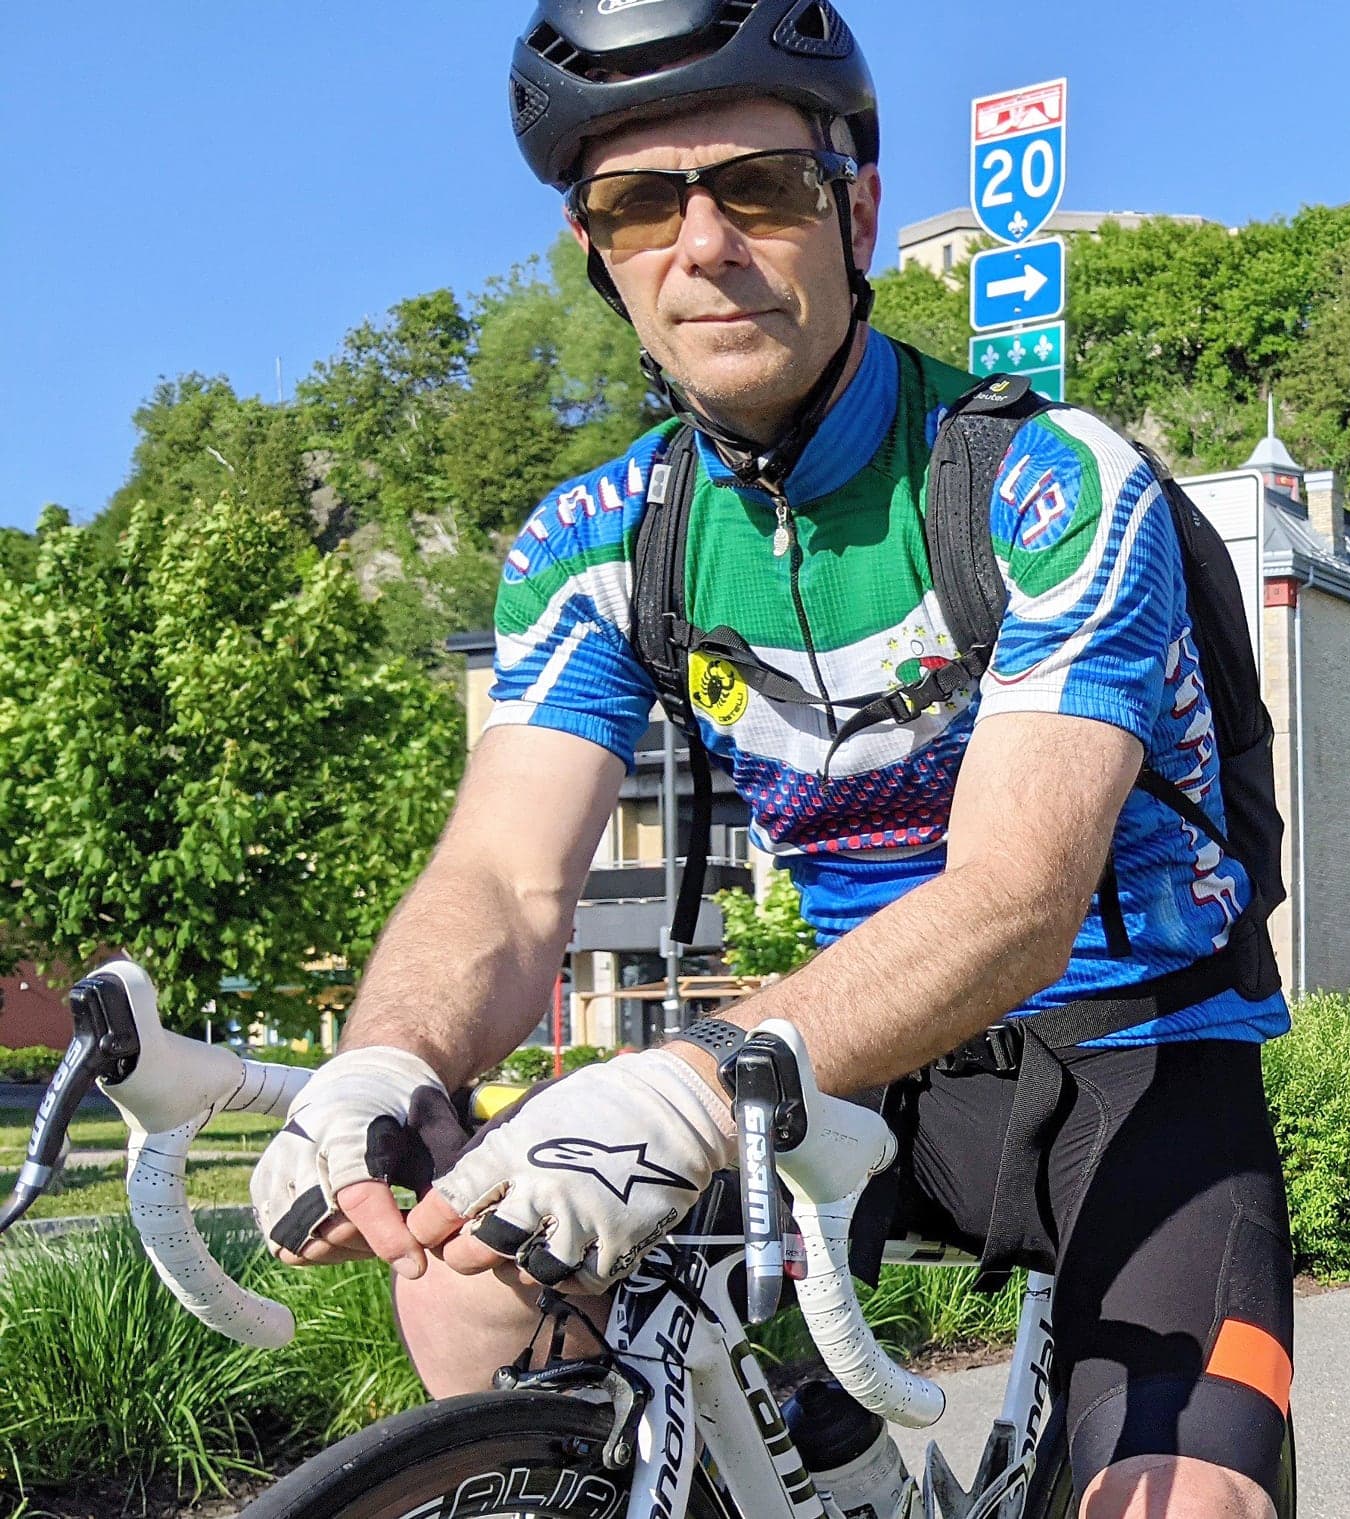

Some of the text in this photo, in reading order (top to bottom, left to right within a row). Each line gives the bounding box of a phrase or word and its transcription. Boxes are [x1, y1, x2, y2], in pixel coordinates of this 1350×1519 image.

[981, 138, 1055, 209] 20
[508, 456, 646, 577] ITALI
[744, 1104, 771, 1234] SRAM
